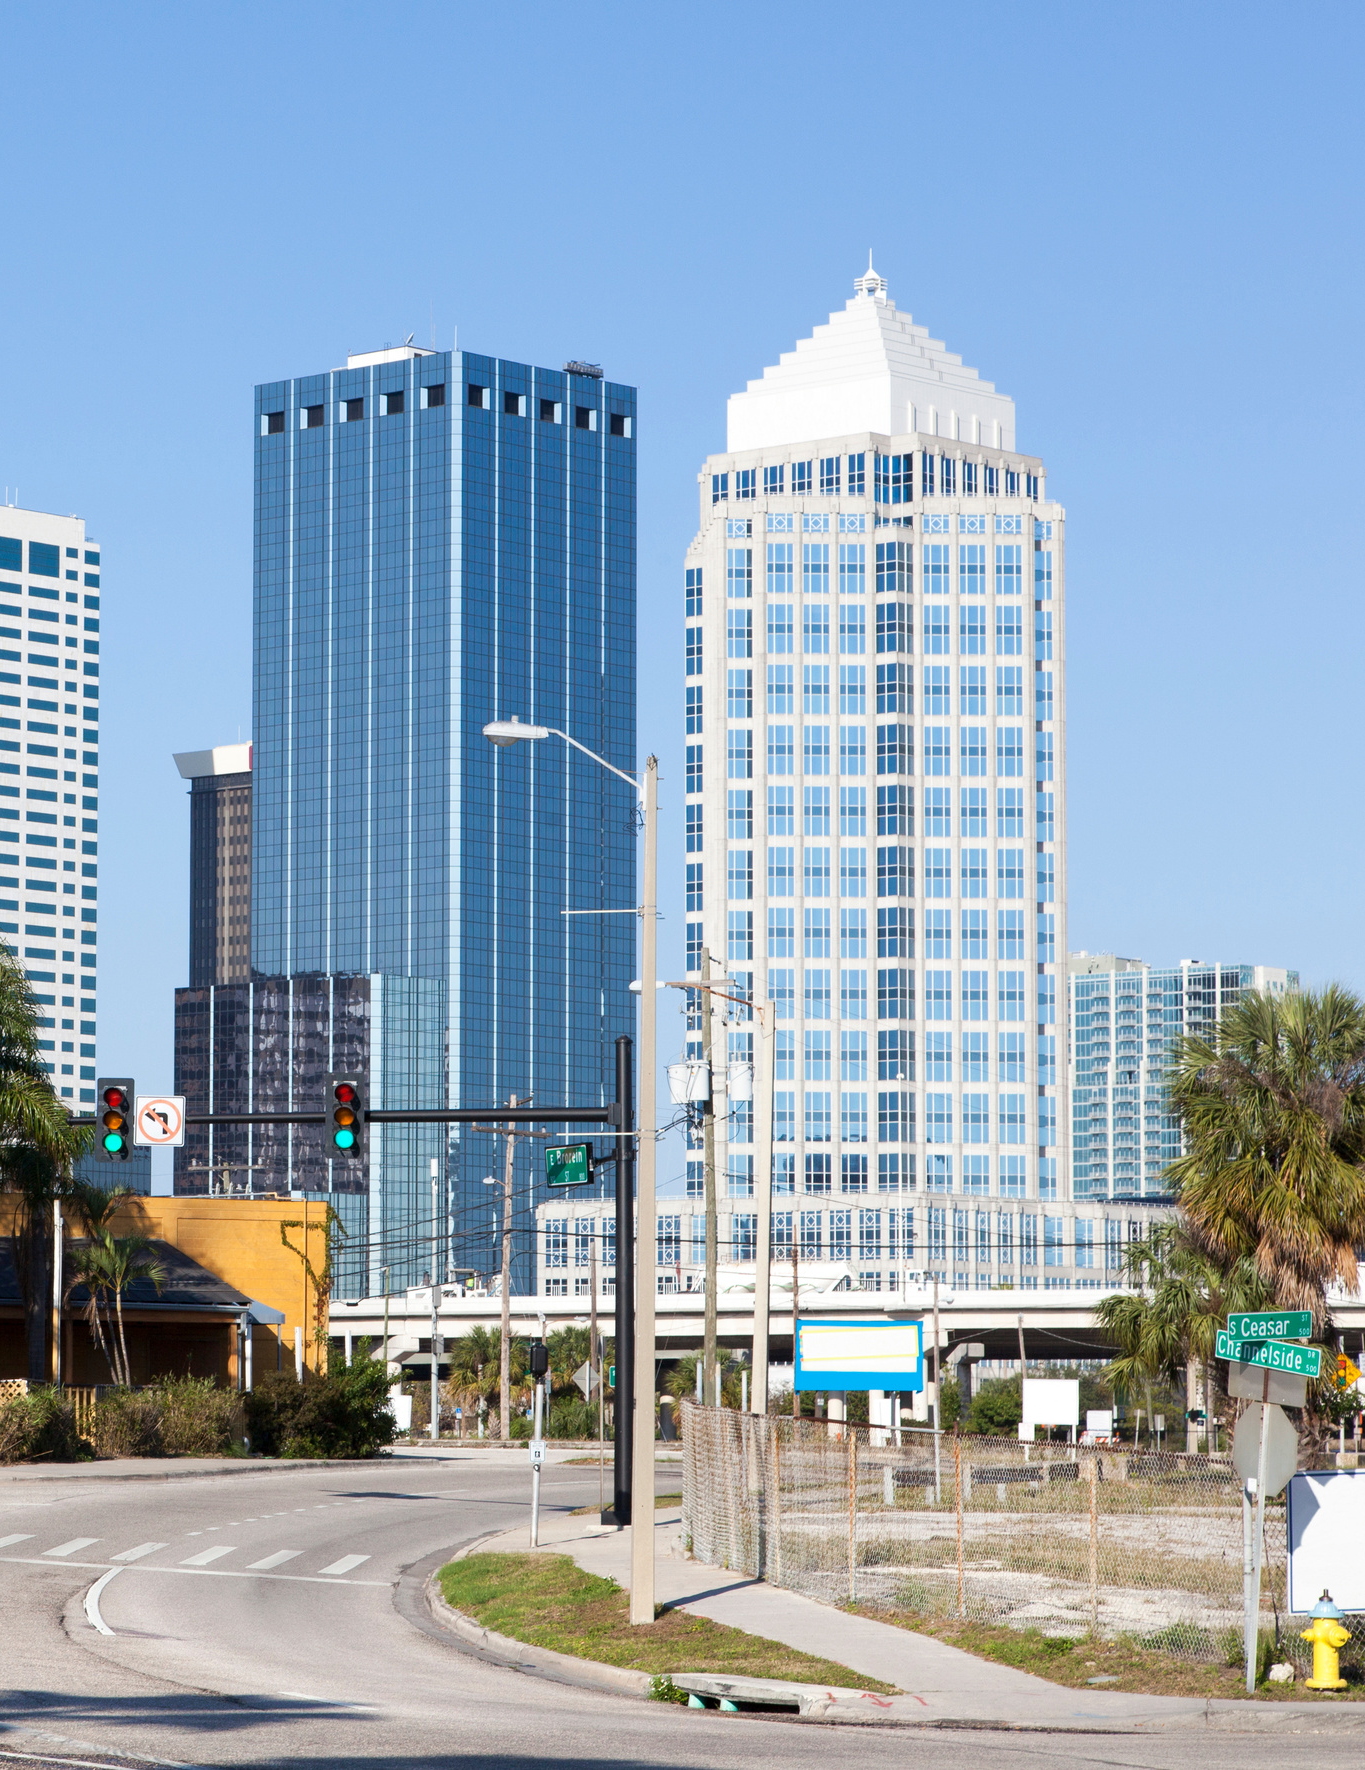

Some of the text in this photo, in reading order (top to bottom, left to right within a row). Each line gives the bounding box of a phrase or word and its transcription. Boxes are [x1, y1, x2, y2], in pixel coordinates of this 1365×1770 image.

[550, 1154, 555, 1166] E
[1301, 1314, 1308, 1322] ST
[1229, 1318, 1290, 1337] S Ceasar
[1299, 1328, 1310, 1336] 500
[1218, 1335, 1302, 1370] Channelside
[1306, 1365, 1317, 1373] 500
